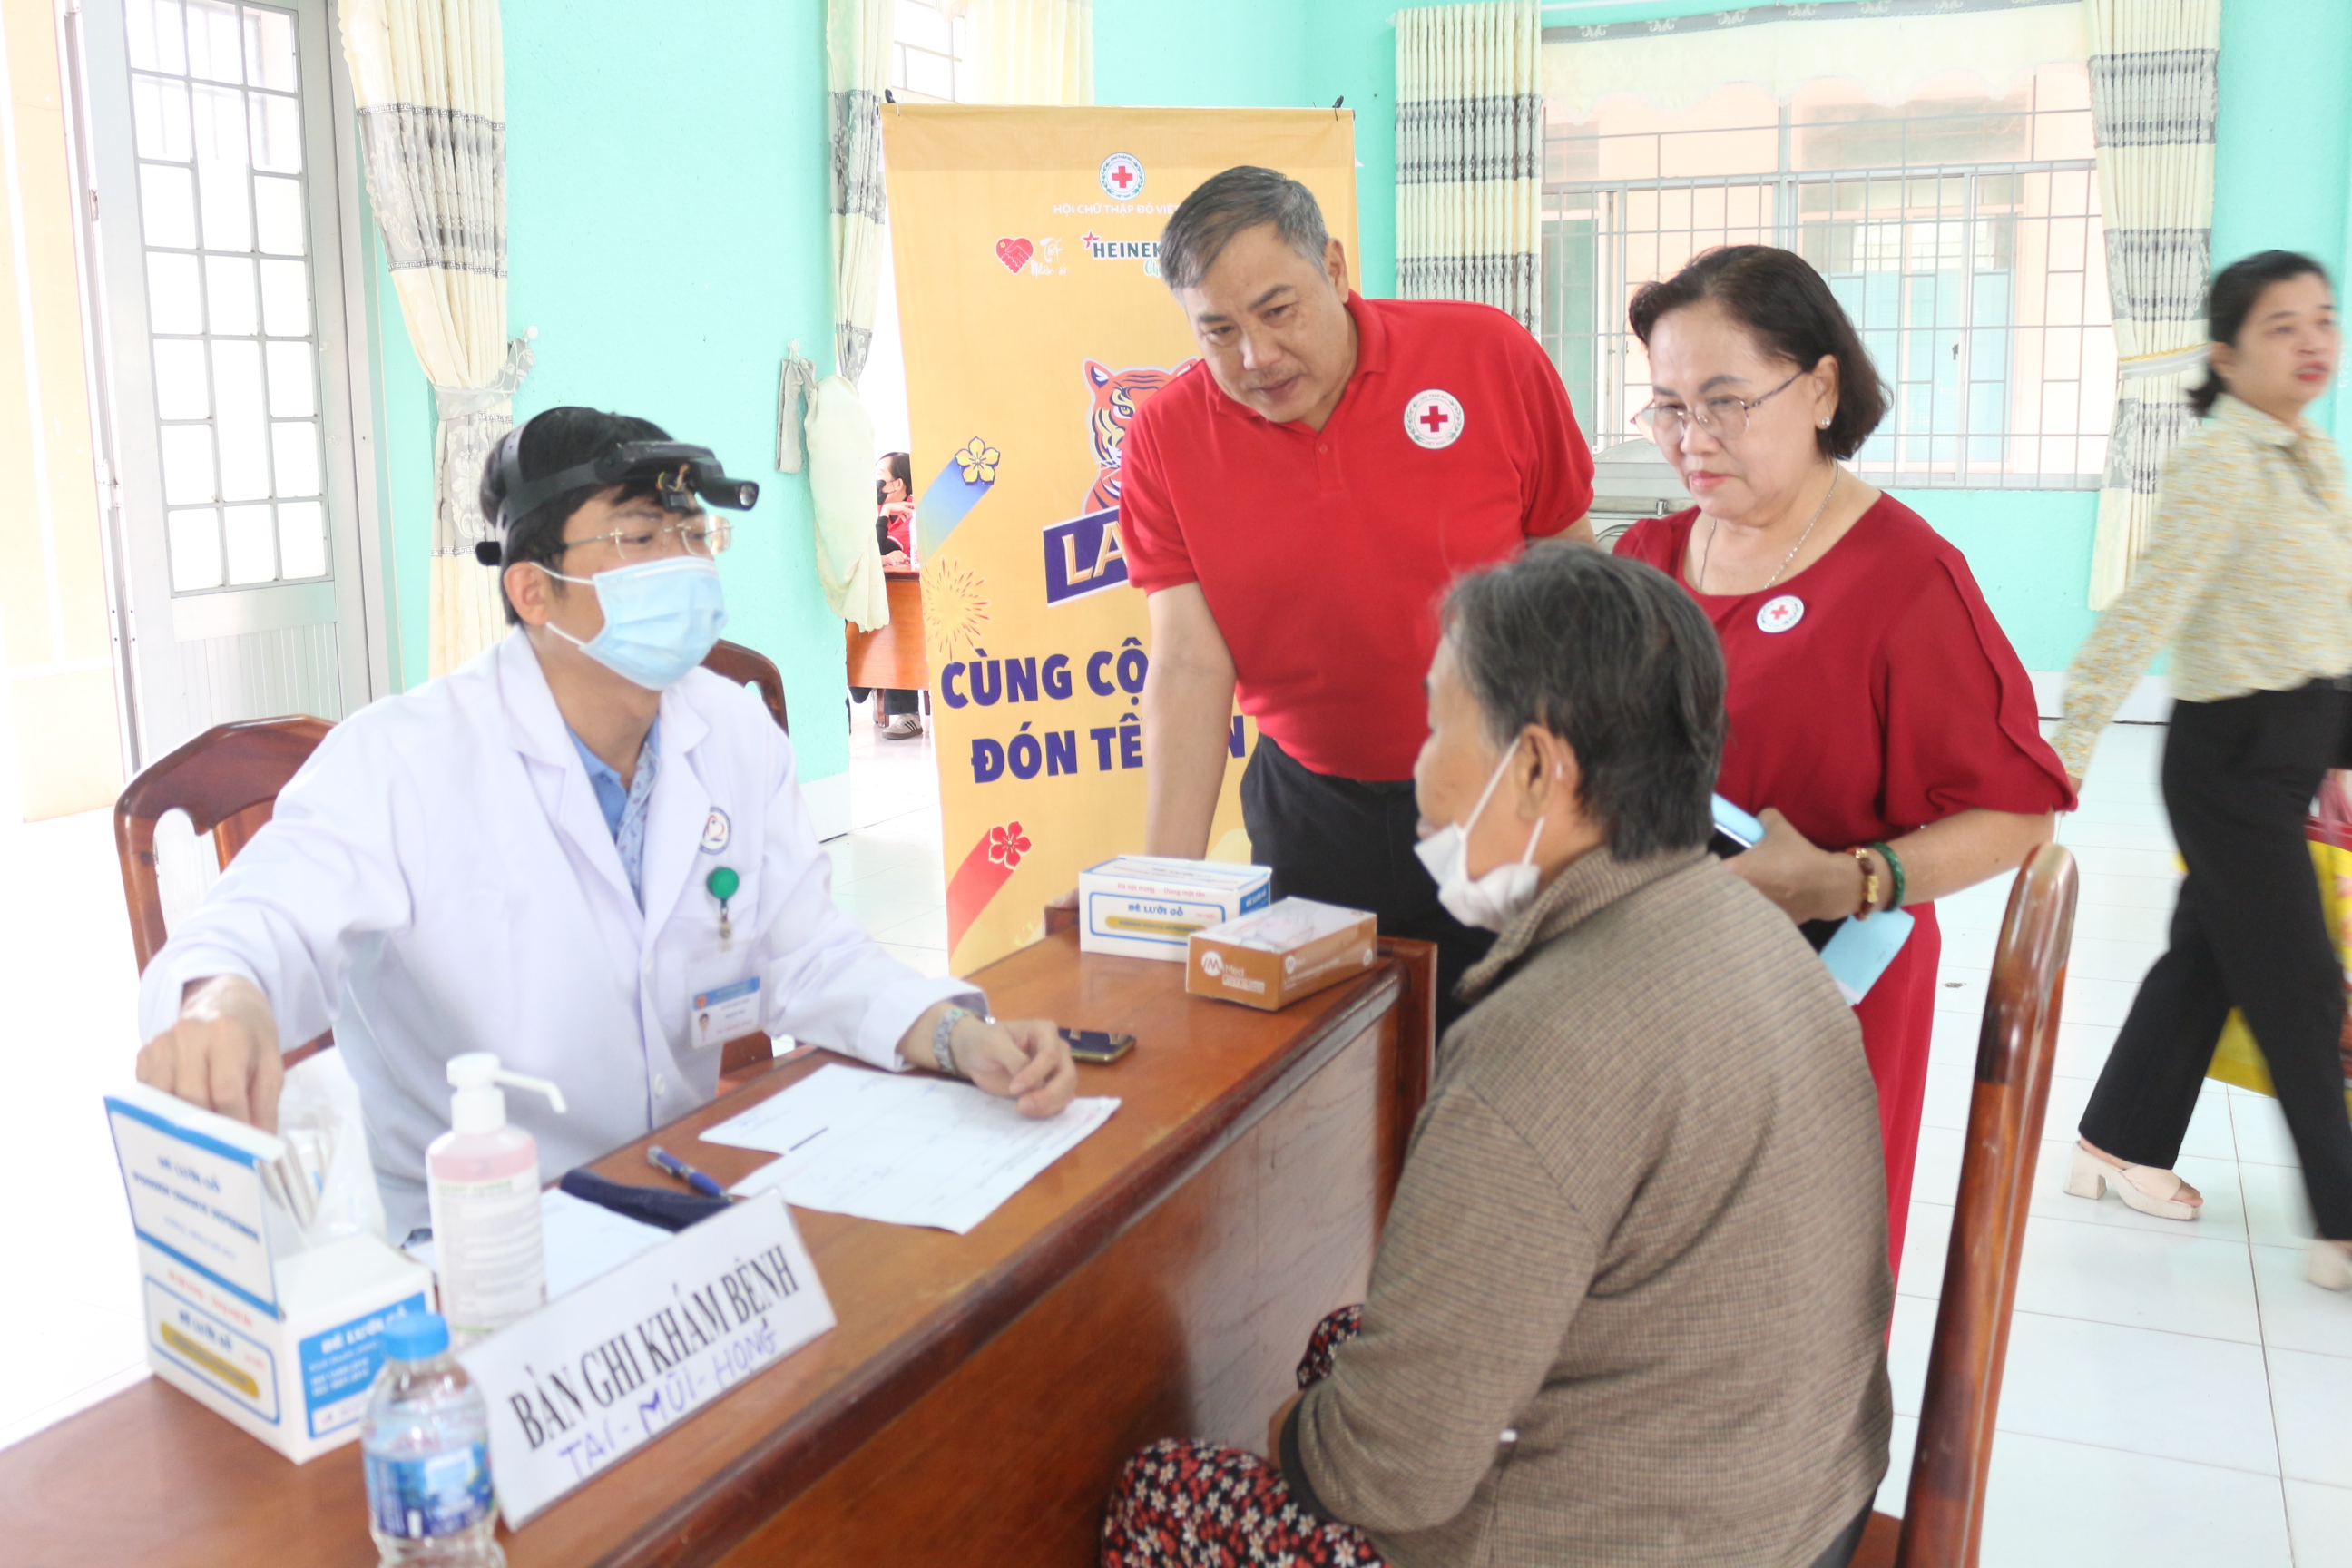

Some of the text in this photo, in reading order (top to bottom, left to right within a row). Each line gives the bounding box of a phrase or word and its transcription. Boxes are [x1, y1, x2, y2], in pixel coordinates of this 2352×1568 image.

[1054, 202, 1074, 217] HỘI
[1077, 202, 1102, 214] CHỮ
[1103, 202, 1134, 217] THẬP
[1136, 201, 1154, 214] ĐỎ
[1093, 242, 1162, 258] HEINEK
[941, 637, 1149, 710] CÙNG CỘ
[971, 721, 1078, 783] ĐÓN
[509, 1364, 589, 1450] BÀN
[580, 1334, 645, 1408] GHI
[635, 1282, 730, 1375] KHÁM
